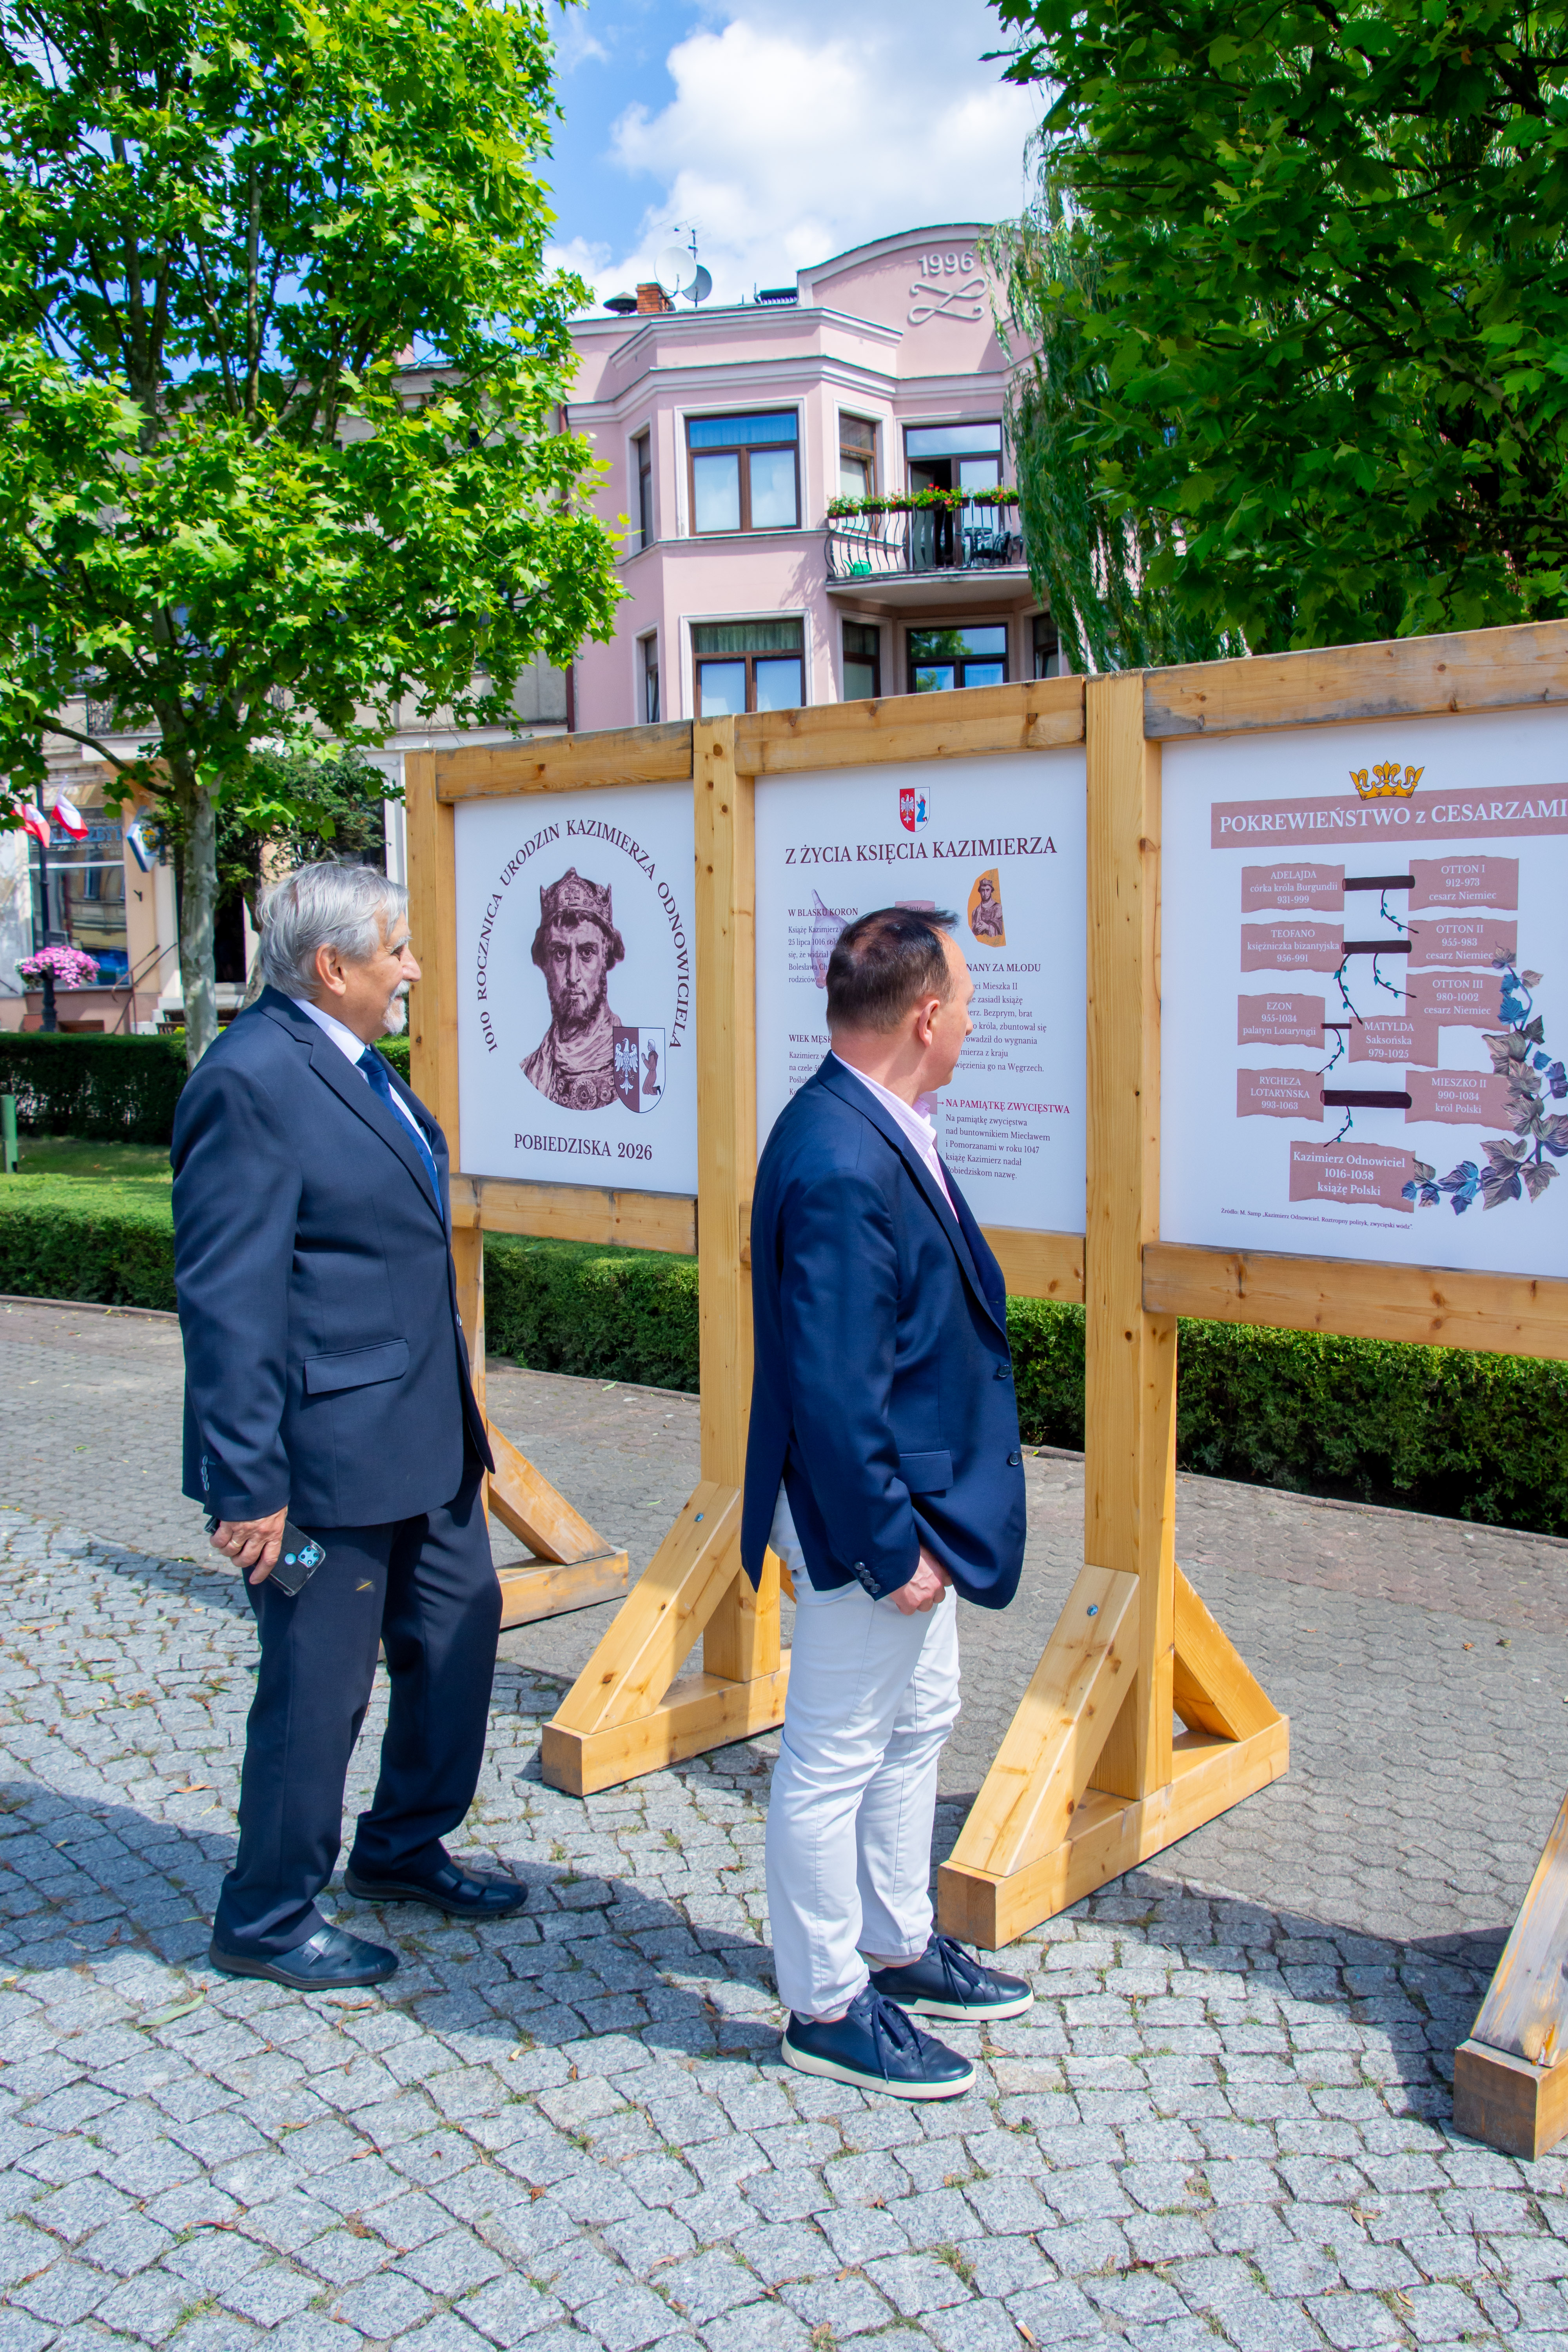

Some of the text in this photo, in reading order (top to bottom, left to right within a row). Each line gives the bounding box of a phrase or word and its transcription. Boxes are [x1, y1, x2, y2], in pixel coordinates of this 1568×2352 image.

[918, 251, 975, 275] 1996
[1220, 799, 1568, 833] POKREWIEŃSTWO z CESARZAMI
[786, 836, 1057, 865] Z ŻYCIA KSIĘCIA KAZIMIERZA
[1441, 865, 1485, 874] OTTON I
[1271, 870, 1316, 880] ADELAJDA
[1274, 883, 1294, 891] króla
[1296, 882, 1338, 892] Burgundii
[1446, 878, 1480, 887] 912-973
[1277, 896, 1309, 904] 931-999
[1459, 891, 1496, 900] Niemiec
[477, 893, 503, 1001] ROCZNICA
[499, 823, 559, 886] URODZIN
[566, 819, 655, 881] KAZIMIERZA
[658, 882, 689, 1048] ODNOWICIELA
[788, 926, 806, 935] Książę
[1271, 929, 1315, 938] TEOFANO
[1436, 925, 1483, 933] OTTON II
[797, 938, 810, 947] lipca
[1442, 938, 1477, 946] 955-983
[1247, 942, 1339, 952] księżniczka bizantyjska
[788, 951, 798, 960] się,
[1455, 951, 1493, 959] Niemiec
[1006, 964, 1041, 972] MŁODU
[1432, 980, 1483, 988] OTTON III
[1002, 996, 1023, 1005] książę
[1436, 993, 1479, 1001] 980-1002
[1267, 1002, 1292, 1010] EZON
[1454, 1006, 1491, 1014] Niemiec
[984, 1009, 1016, 1018] Bezprym,
[979, 1022, 998, 1031] króla,
[1000, 1023, 1035, 1031] zbuntował
[1038, 1024, 1047, 1033] się
[1364, 1022, 1414, 1031] MATYLDA
[1243, 1027, 1316, 1037] palatyn Lotaryngii
[811, 1035, 831, 1044] MĘSK
[1005, 1037, 1037, 1046] wygnania
[1366, 1035, 1412, 1045] Saksońska
[991, 1049, 1008, 1058] kraju
[1368, 1049, 1409, 1058] 979-1025
[955, 1061, 985, 1070] więzienia
[1008, 1063, 1044, 1073] Węgrzech.
[1259, 1076, 1301, 1085] RYCHEZA
[1431, 1078, 1486, 1088] MIESZKO II
[1250, 1087, 1310, 1098] LOTARYŃSKA
[1438, 1091, 1479, 1101] 990-1034
[946, 1099, 1070, 1114] NA PAMIĄTKĘ ZWYCIĘSTWA
[1261, 1101, 1298, 1110] 993-1063
[1435, 1103, 1481, 1114] król Polski
[957, 1115, 987, 1125] pamiątkę
[989, 1118, 1027, 1127] zwycięstwa
[960, 1128, 1009, 1138] buntownikiem
[1010, 1131, 1050, 1141] Miecławem
[514, 1134, 652, 1160] POBIEDZISKA 2026
[950, 1140, 996, 1151] Pomorzanami
[946, 1152, 965, 1163] książę
[967, 1154, 1001, 1164] Kazimierz
[1294, 1152, 1405, 1168] Kazimierz Odnowiciel
[994, 1171, 1017, 1180] nazwę.
[1325, 1168, 1374, 1180] 1016-1058
[1318, 1182, 1381, 1196] książę Polski
[1322, 1217, 1348, 1225] Roztropny
